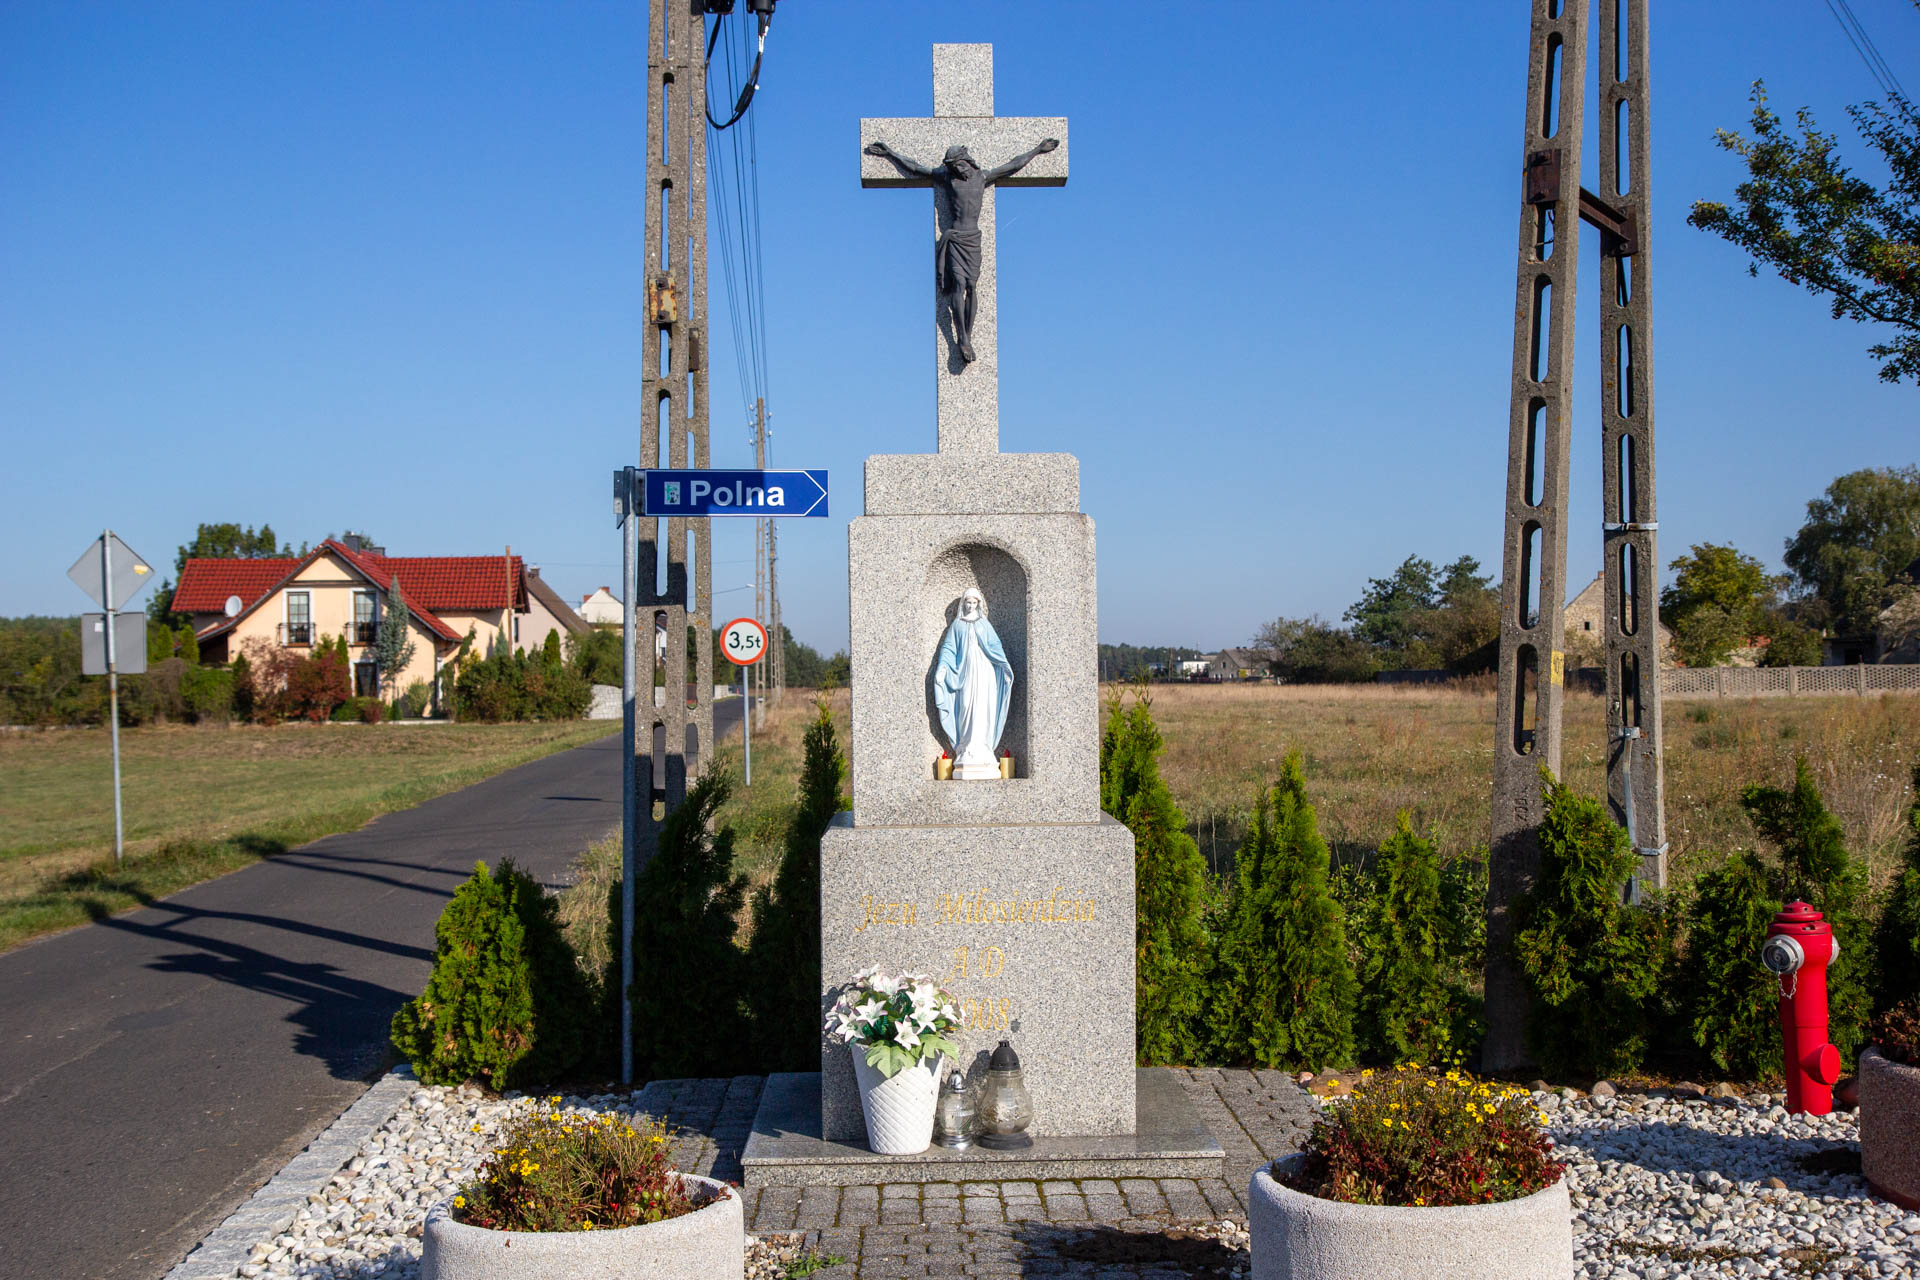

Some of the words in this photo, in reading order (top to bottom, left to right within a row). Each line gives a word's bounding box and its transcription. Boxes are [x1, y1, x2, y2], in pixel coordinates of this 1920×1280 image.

[690, 480, 785, 506] Polna
[728, 631, 761, 651] 3,5t
[855, 894, 918, 932] Jezu
[944, 945, 969, 983] A
[978, 945, 1006, 978] D
[946, 997, 1011, 1031] 008
